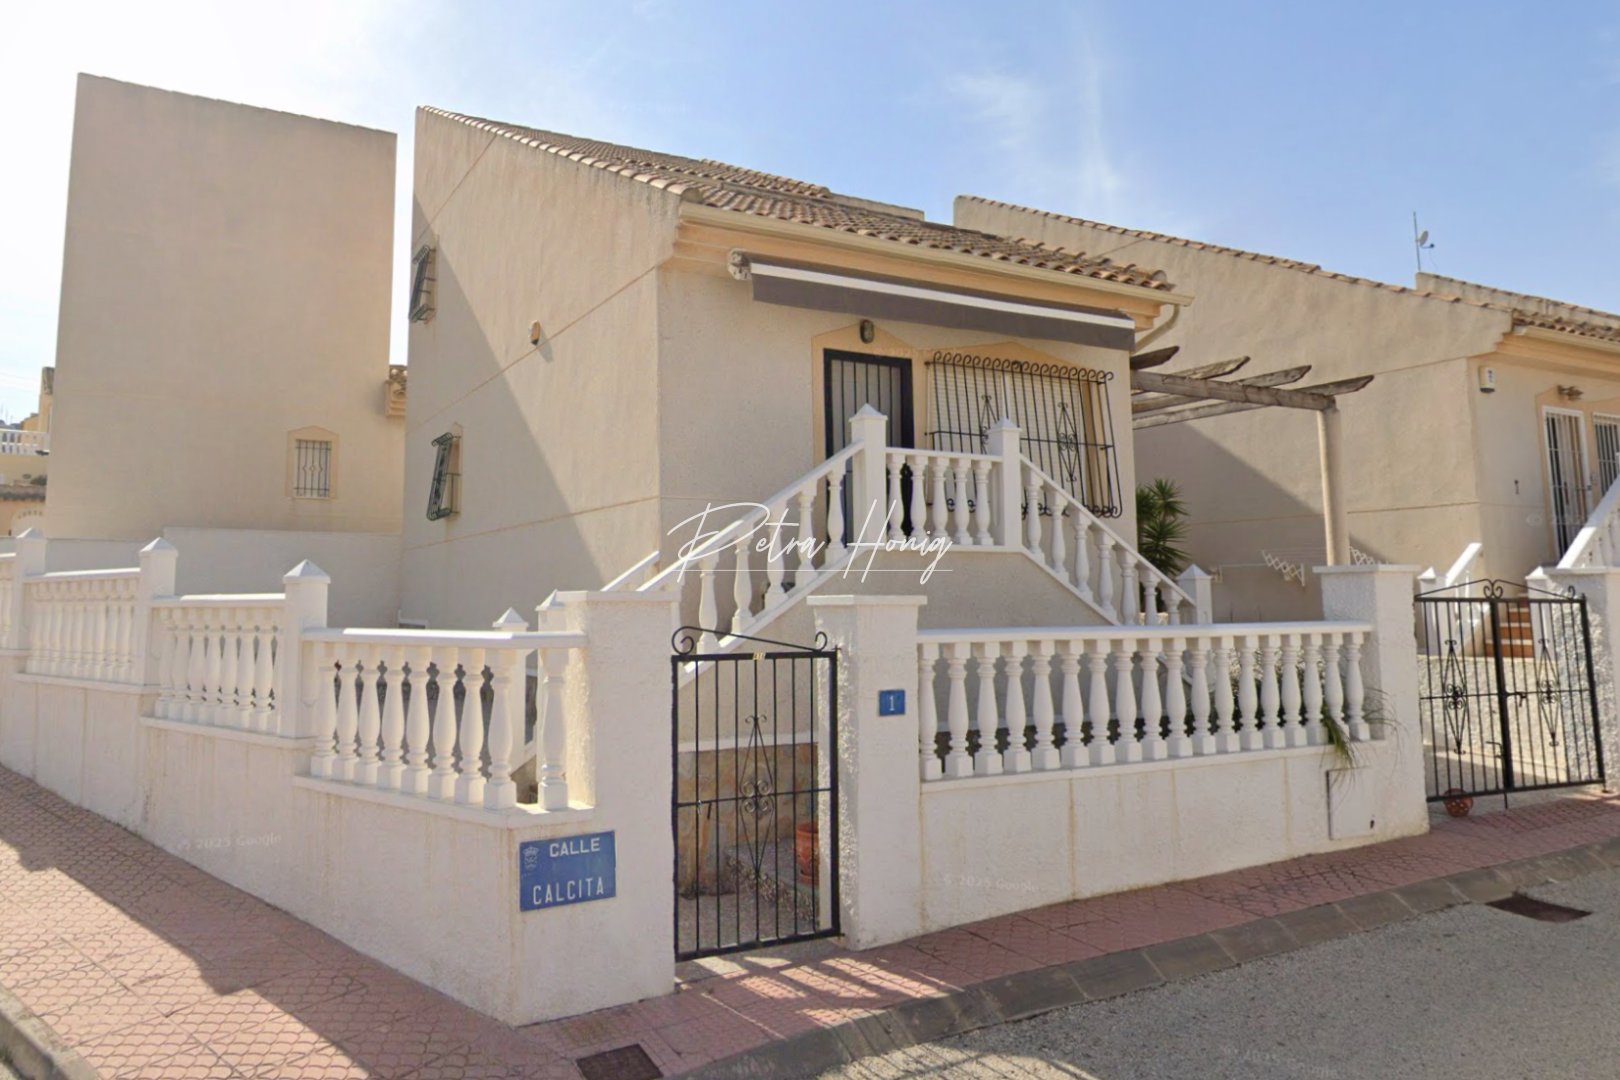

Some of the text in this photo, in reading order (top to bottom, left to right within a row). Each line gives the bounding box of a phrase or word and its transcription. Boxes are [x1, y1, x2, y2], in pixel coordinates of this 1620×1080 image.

[888, 695, 896, 711] 1
[549, 837, 601, 858] CALLE
[532, 876, 604, 906] CALCITA
